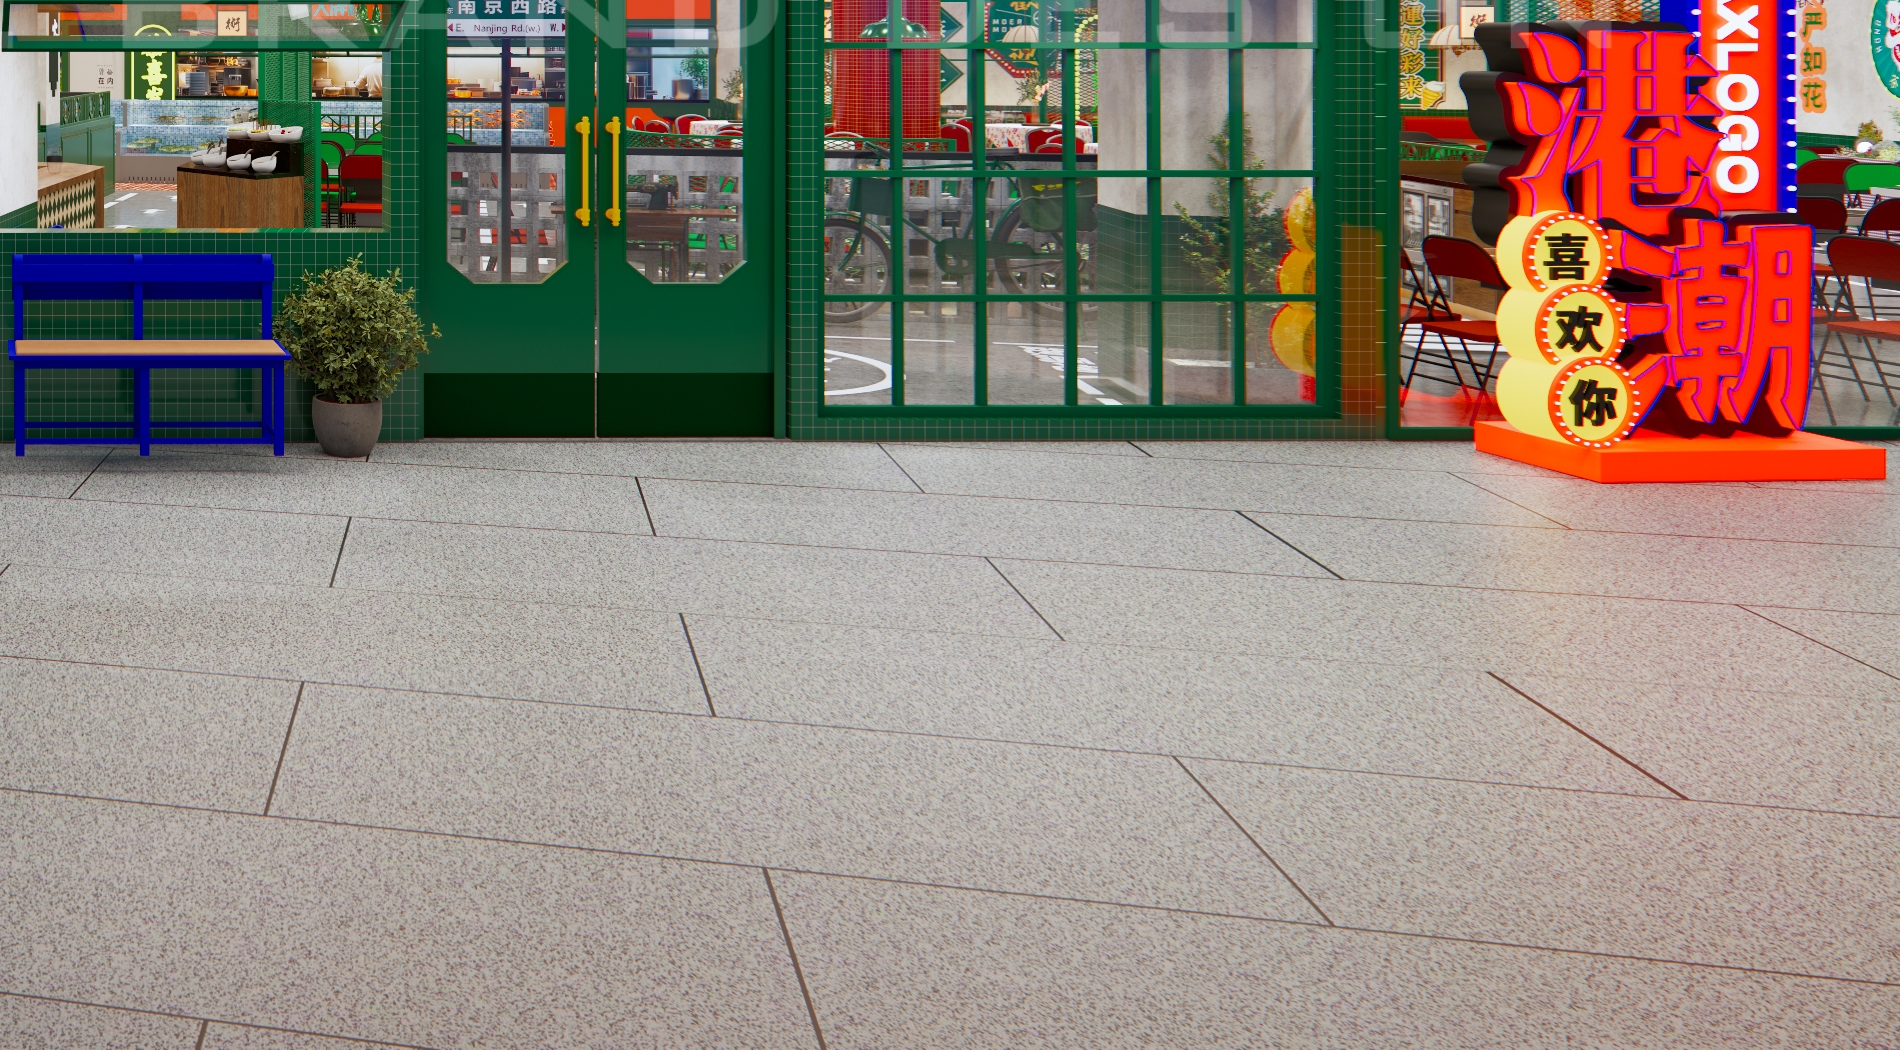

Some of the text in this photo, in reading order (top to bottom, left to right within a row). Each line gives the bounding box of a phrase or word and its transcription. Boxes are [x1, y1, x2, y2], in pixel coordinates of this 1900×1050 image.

[474, 24, 507, 34] Nanjing
[1543, 233, 1618, 428] 喜欢你
